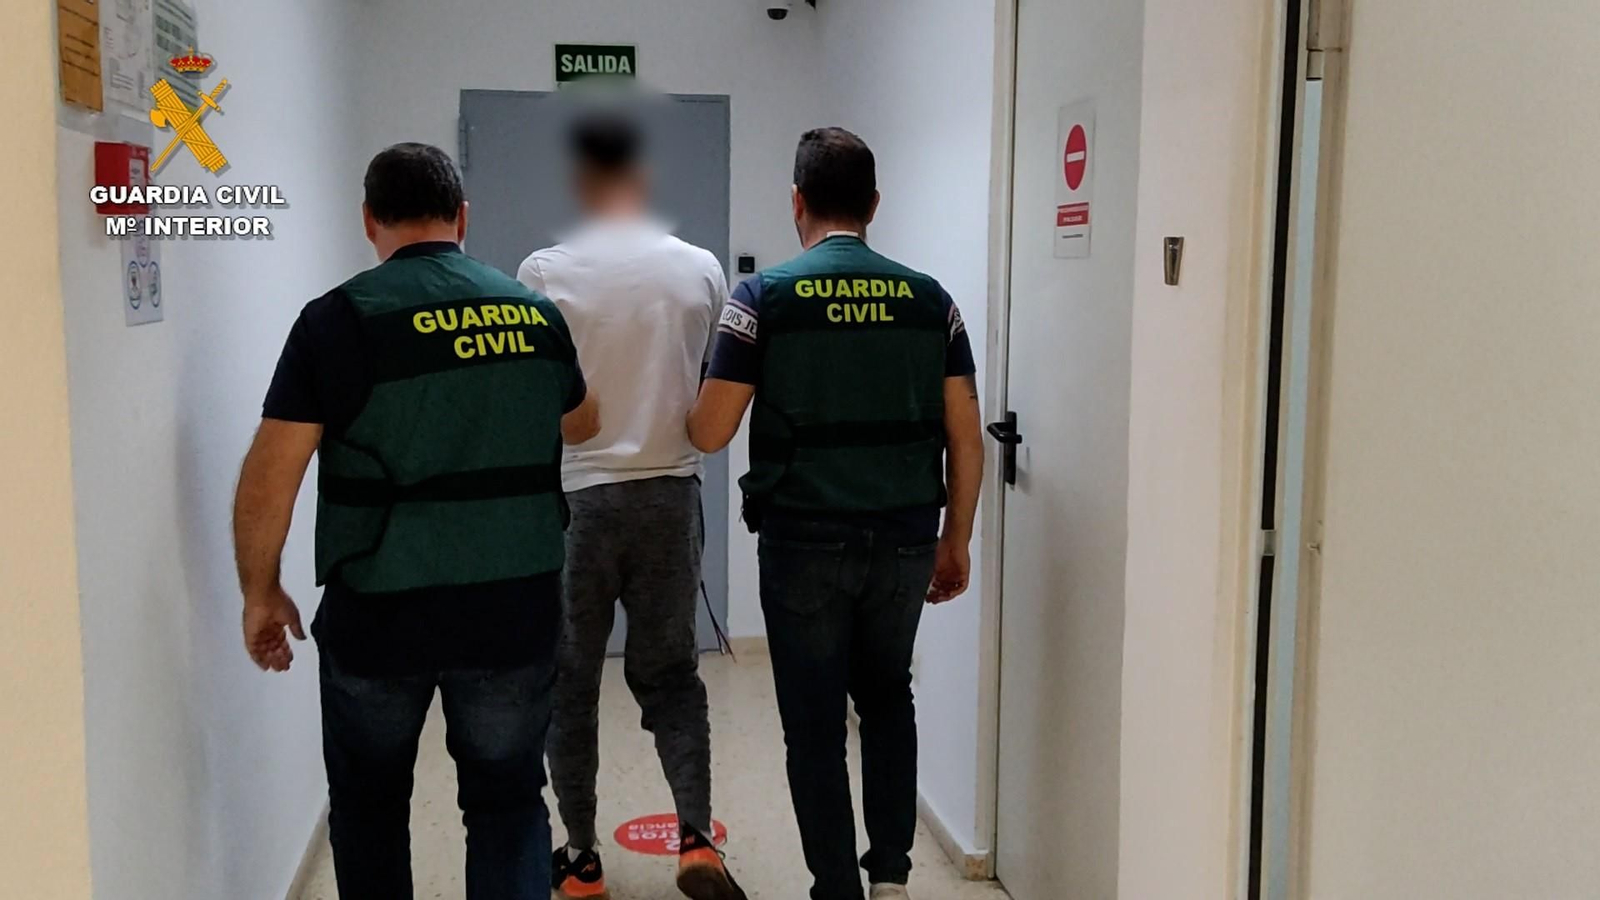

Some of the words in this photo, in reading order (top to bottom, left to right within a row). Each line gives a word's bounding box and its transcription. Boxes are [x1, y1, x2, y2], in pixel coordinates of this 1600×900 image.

[561, 54, 631, 73] SALIDA
[795, 279, 914, 298] GUARDIA
[412, 304, 549, 334] GUARDIA
[826, 303, 894, 322] CIVIL
[453, 330, 535, 359] CIVIL
[628, 831, 680, 840] tros
